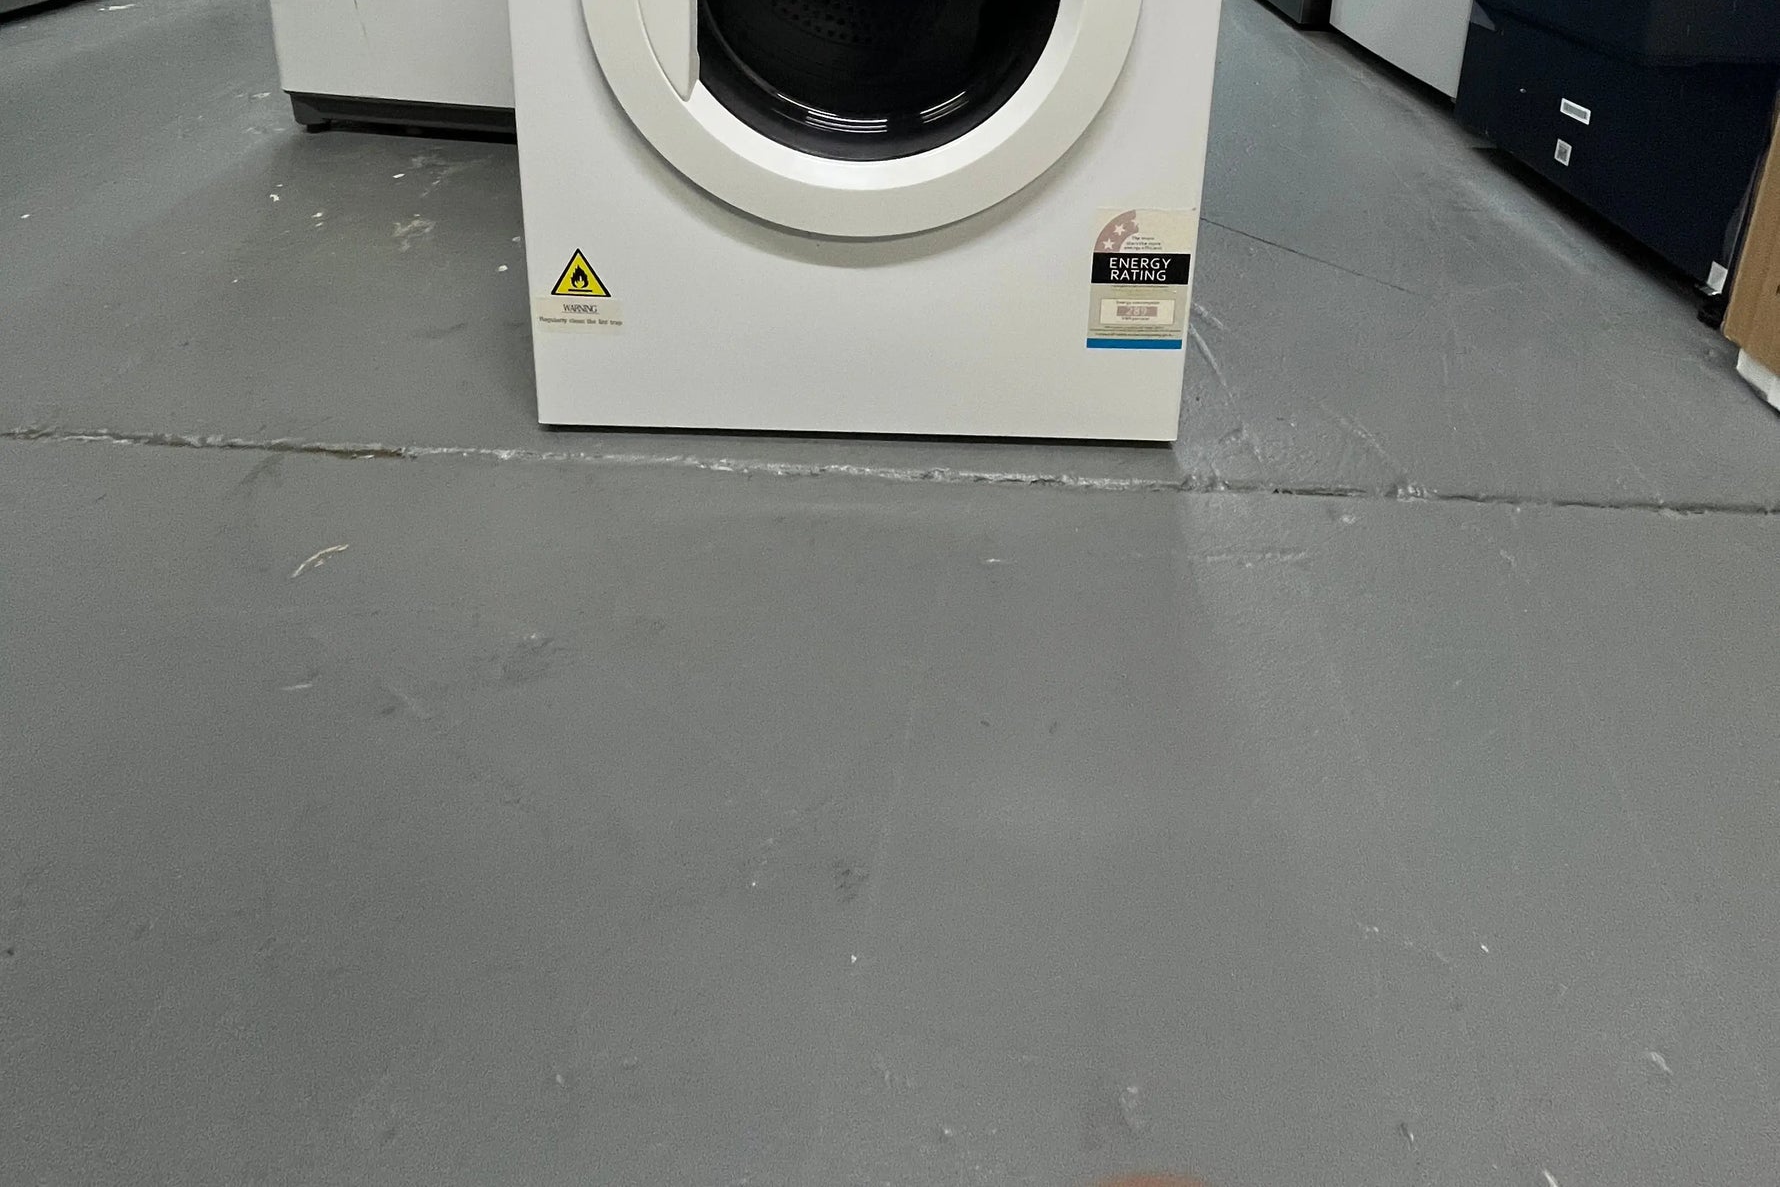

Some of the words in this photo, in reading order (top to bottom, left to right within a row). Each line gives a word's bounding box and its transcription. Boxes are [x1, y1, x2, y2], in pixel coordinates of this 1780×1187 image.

[1109, 257, 1171, 269] ENERGY
[1110, 269, 1166, 282] RATING
[563, 304, 598, 313] WARNING
